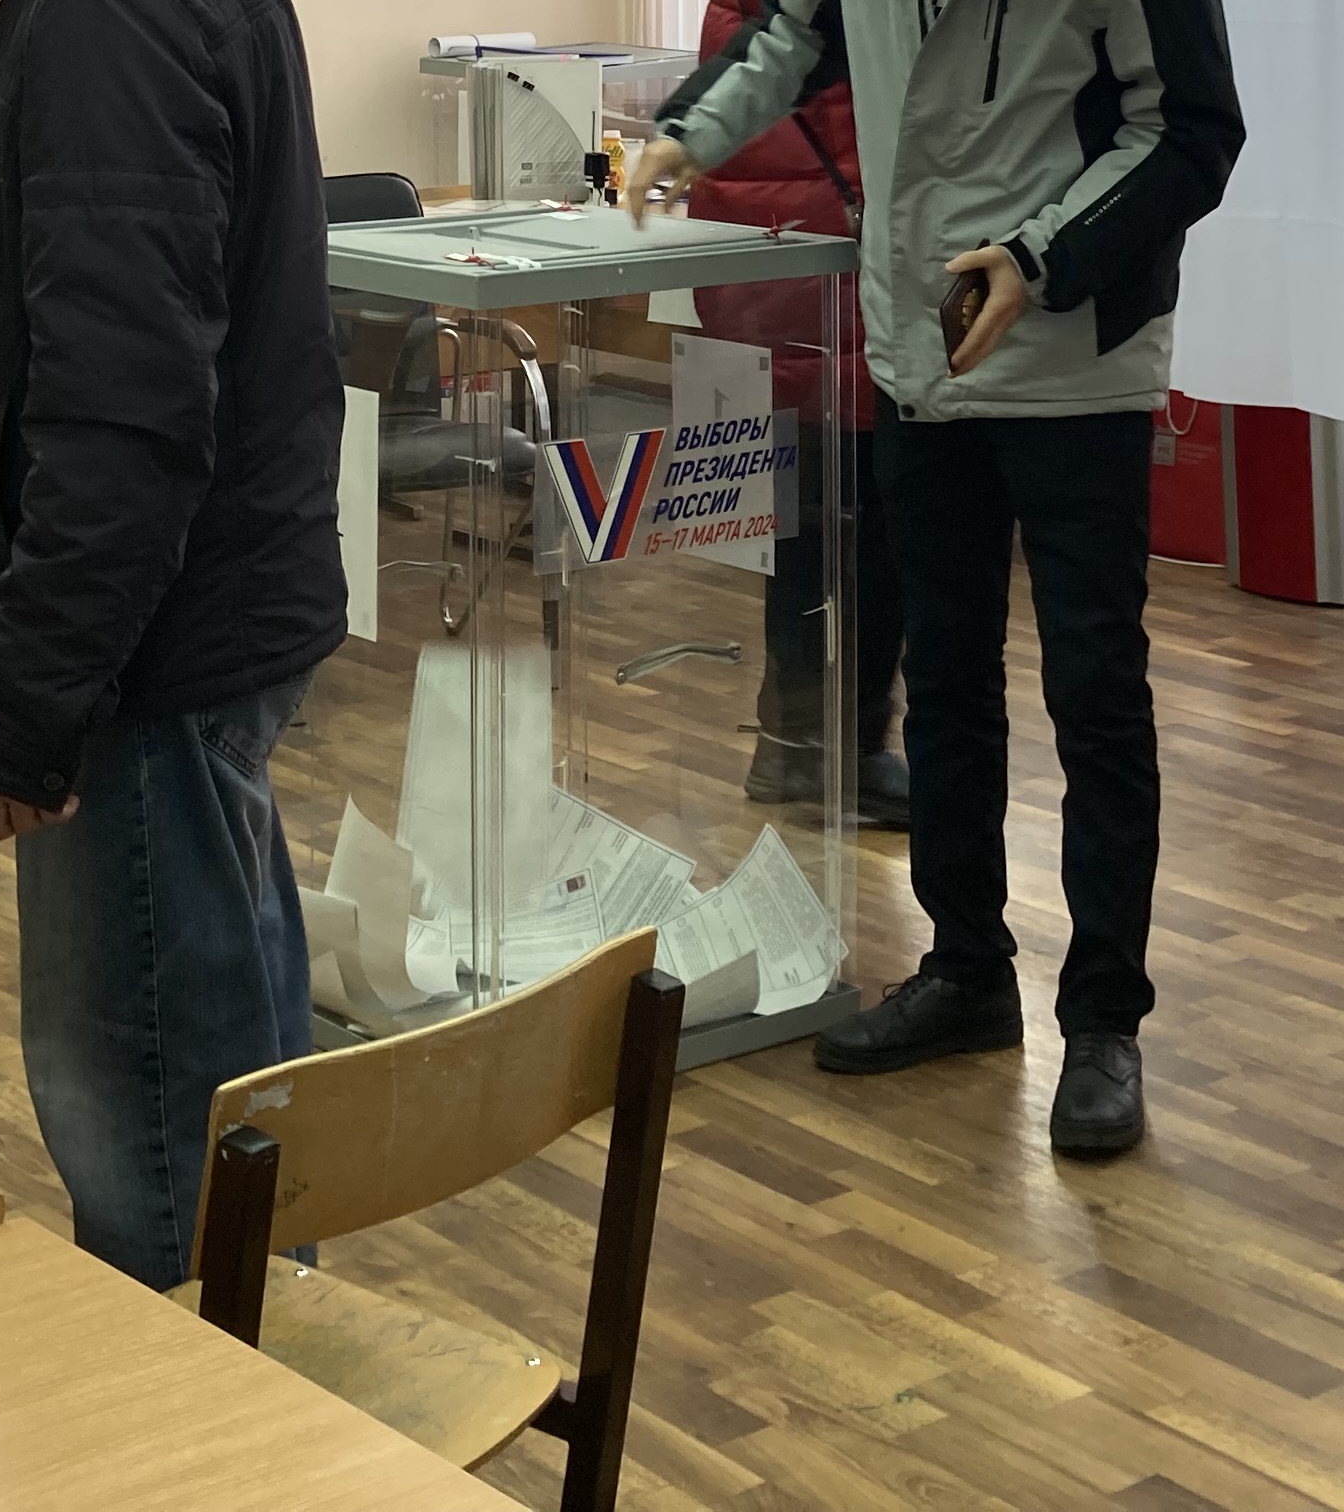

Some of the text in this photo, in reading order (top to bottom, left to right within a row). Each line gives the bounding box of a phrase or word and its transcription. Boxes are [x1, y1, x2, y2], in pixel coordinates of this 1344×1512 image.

[674, 415, 772, 452] ВЫБОРЫ
[663, 445, 797, 488] ПРЕЗИДЕНТА
[653, 487, 742, 524] РОССИИ
[690, 518, 744, 549] МАРТА
[744, 513, 779, 539] 2024
